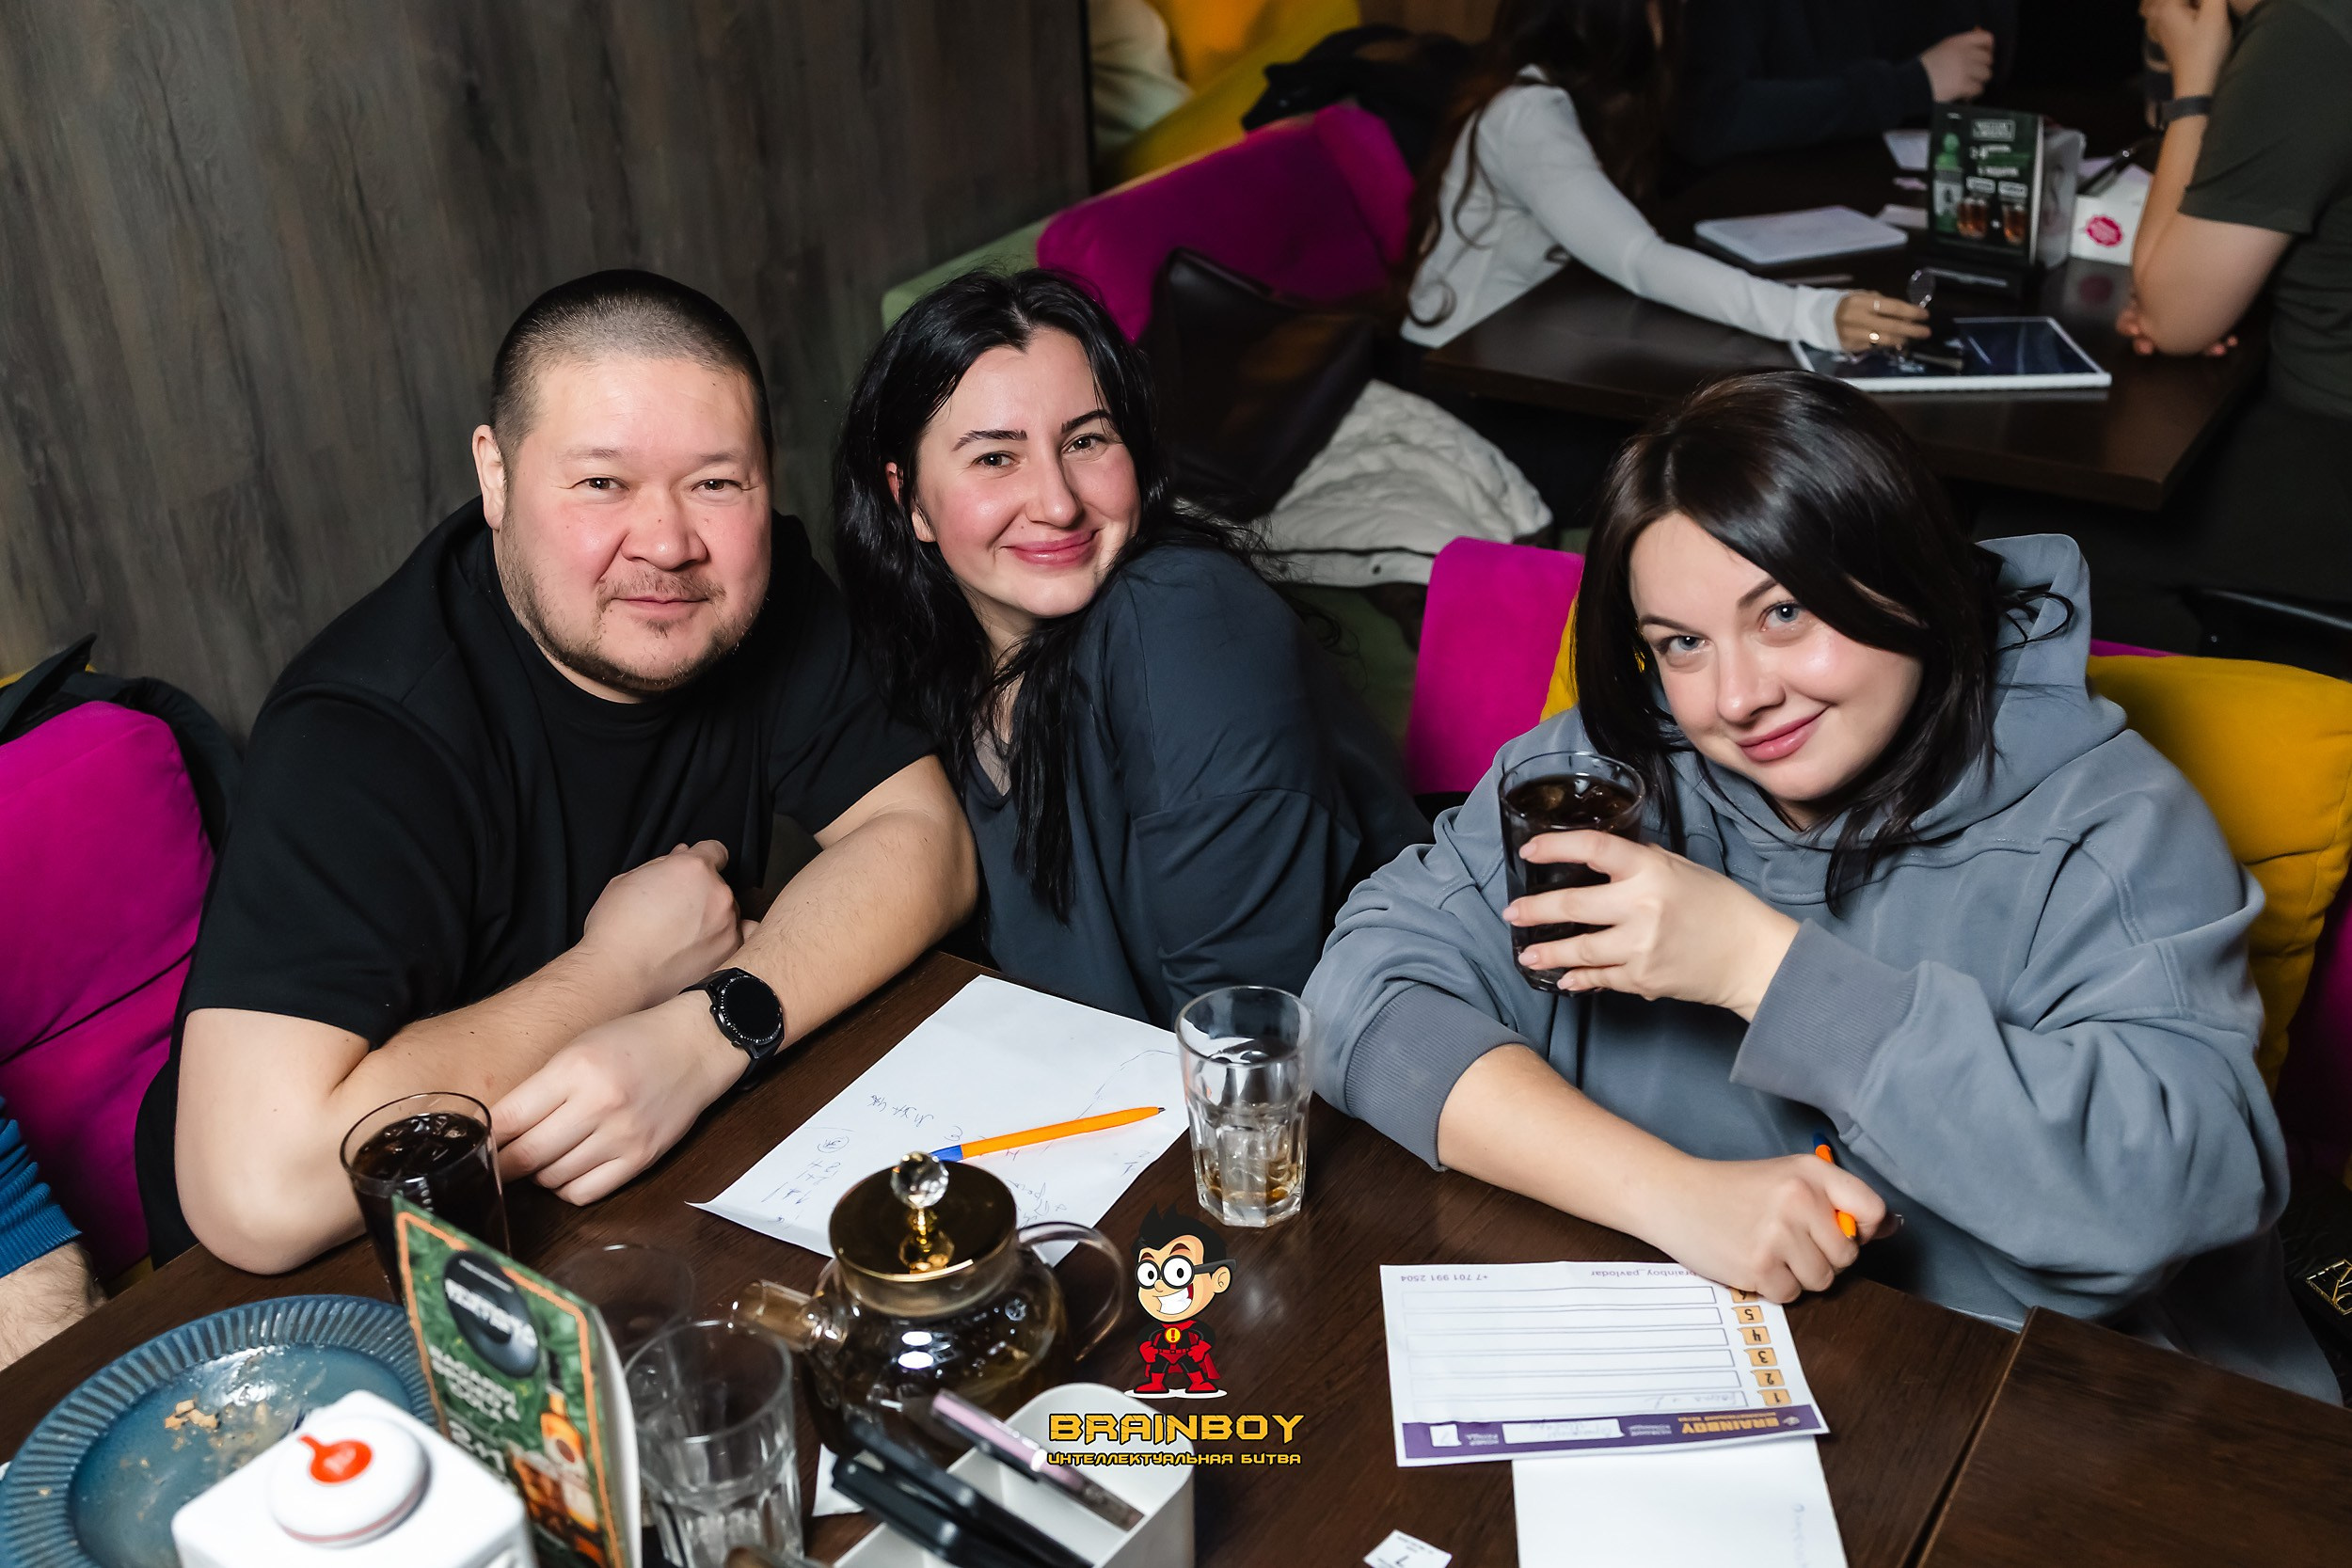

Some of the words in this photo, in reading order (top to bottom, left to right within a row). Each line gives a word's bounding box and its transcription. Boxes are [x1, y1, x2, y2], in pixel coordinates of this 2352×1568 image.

[1744, 1308, 1755, 1321] 5
[1752, 1329, 1761, 1342] 4
[1757, 1351, 1768, 1364] 3
[1764, 1372, 1774, 1386] 2
[1773, 1392, 1781, 1403] 1
[1680, 1417, 1780, 1434] BRAINBOY
